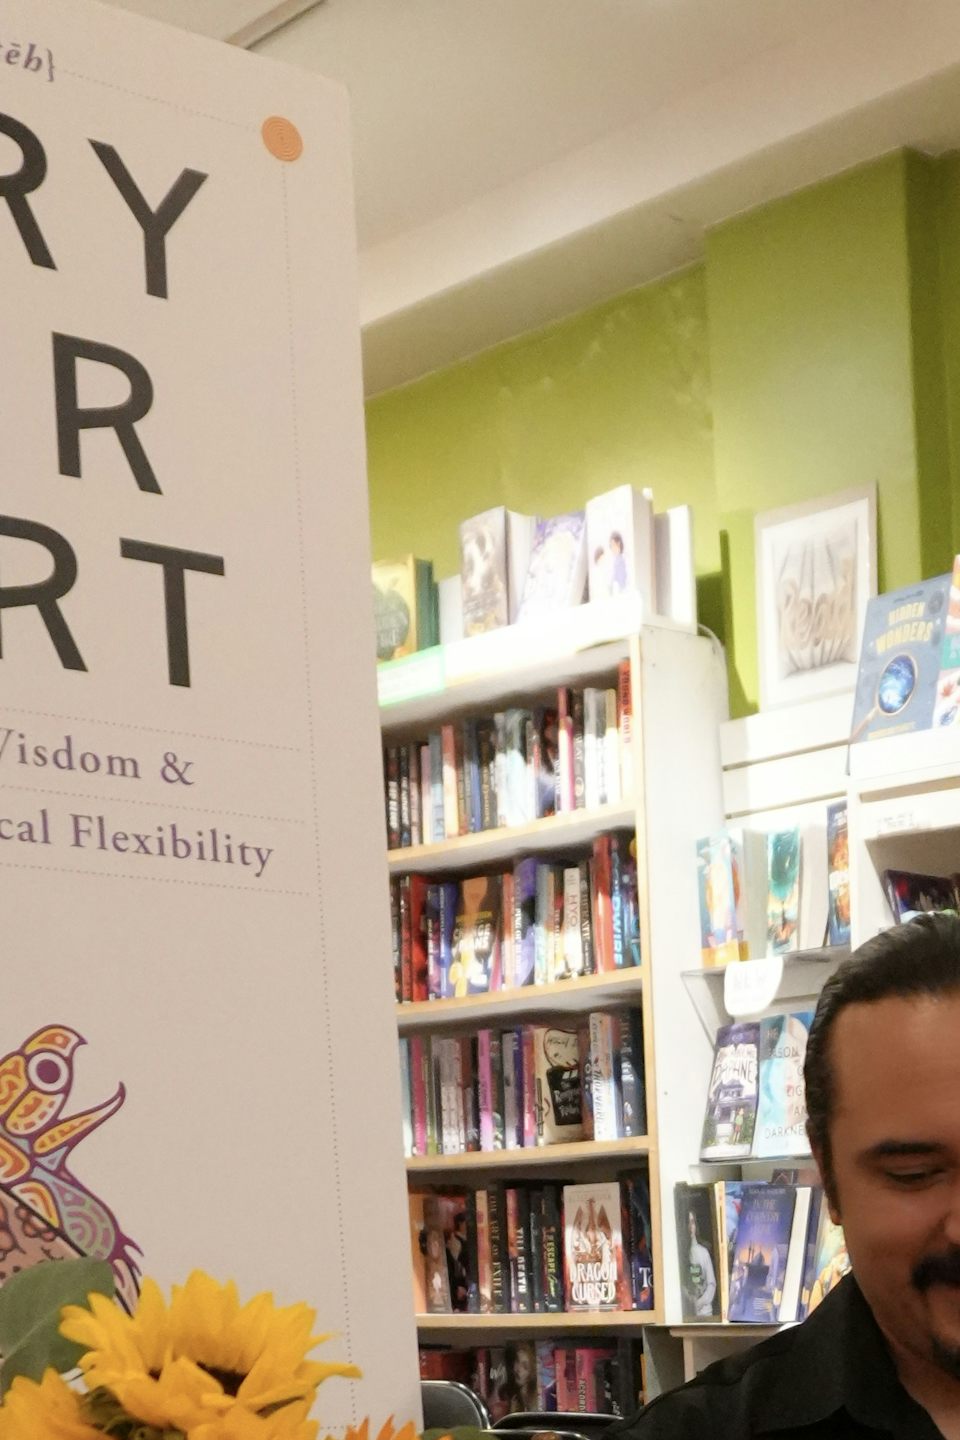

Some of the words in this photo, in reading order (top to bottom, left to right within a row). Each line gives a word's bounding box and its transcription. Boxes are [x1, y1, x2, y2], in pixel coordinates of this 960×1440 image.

[52, 331, 162, 495] R
[888, 602, 926, 624] HIDDEN
[876, 621, 934, 654] WONDERS
[160, 752, 195, 785] &
[0, 809, 51, 844] cal
[70, 813, 274, 878] Flexibility
[545, 1242, 555, 1272] ESCAPE
[569, 1261, 617, 1283] DRAGON
[514, 1255, 528, 1293] DEATH
[571, 1281, 616, 1304] CURSED
